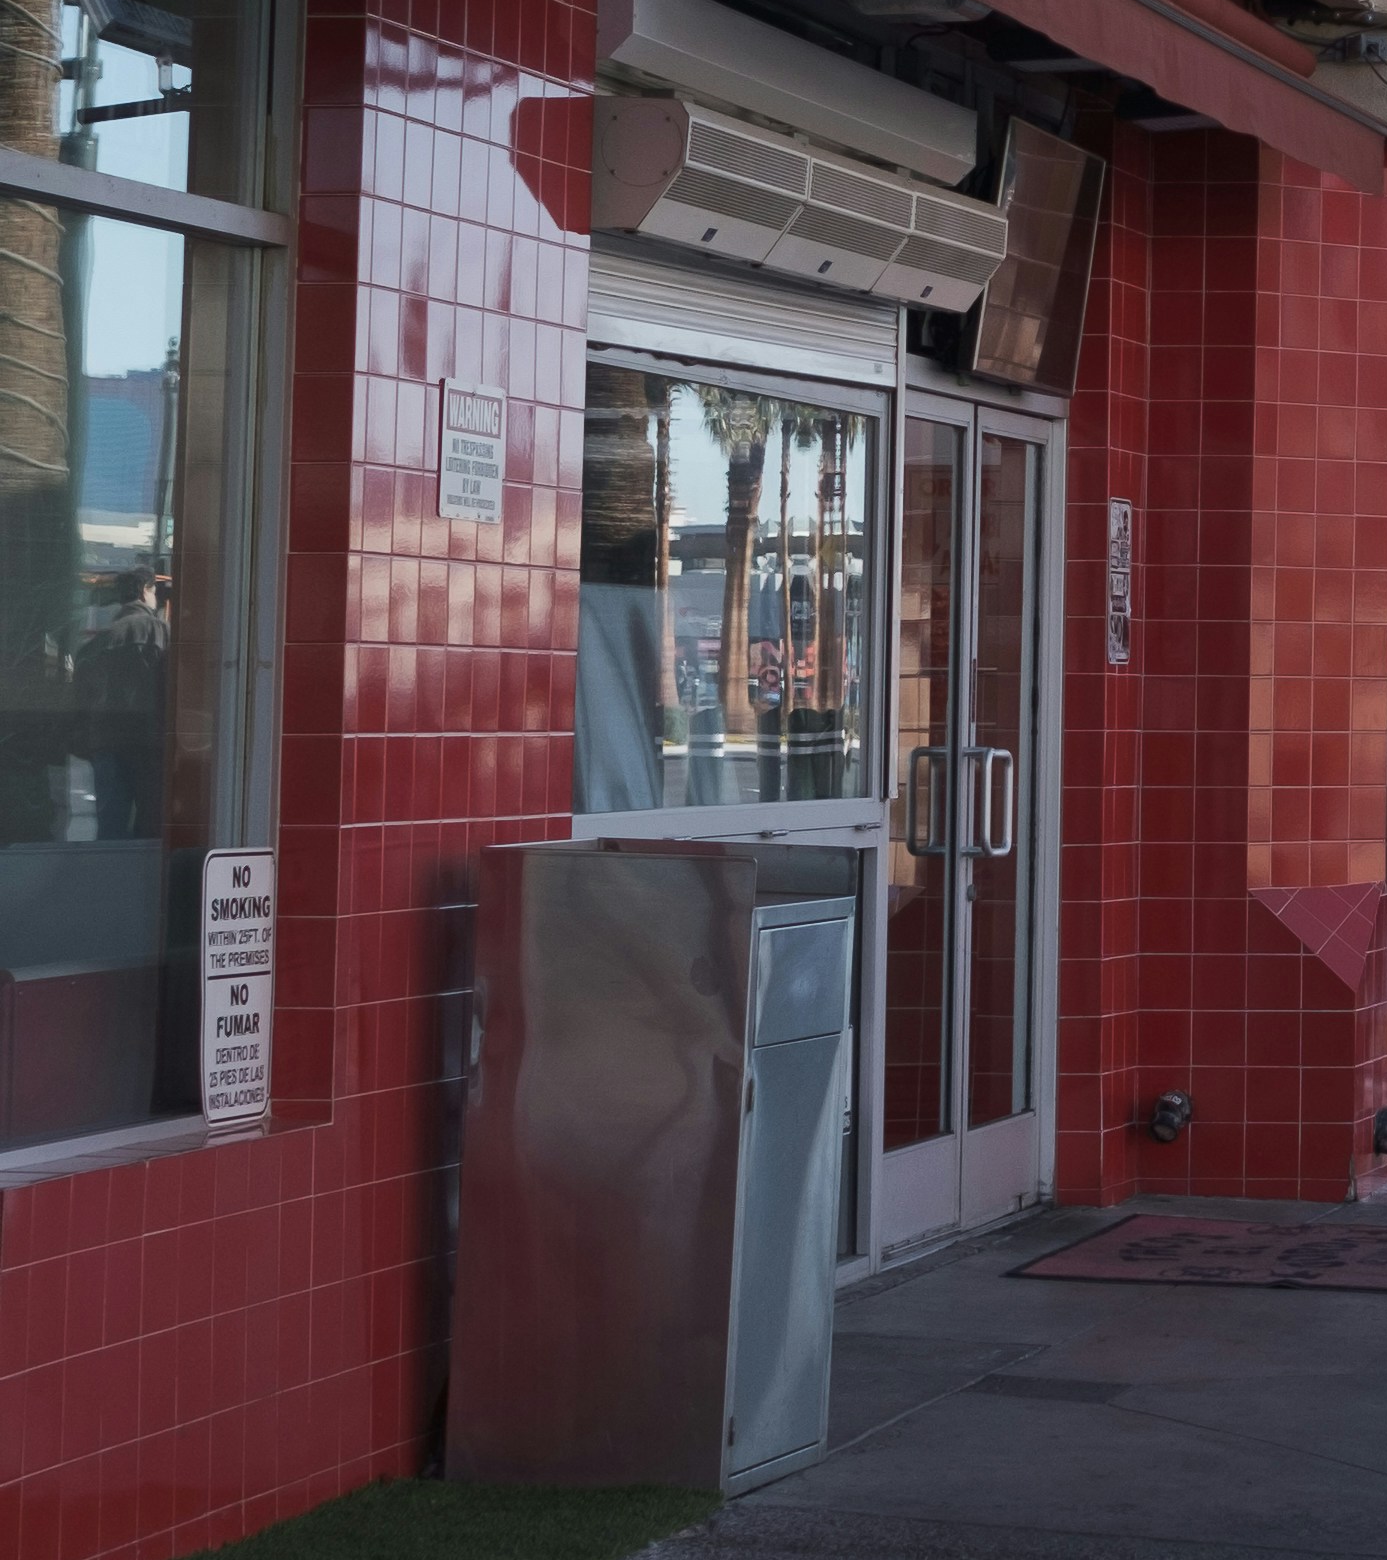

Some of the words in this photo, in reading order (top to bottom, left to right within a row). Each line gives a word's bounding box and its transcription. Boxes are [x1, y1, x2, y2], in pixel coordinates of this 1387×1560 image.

[449, 392, 500, 436] WARNING
[232, 864, 252, 889] NO
[211, 895, 271, 922] SMOKING
[208, 930, 238, 948] WITHIN
[210, 953, 227, 970] THE
[228, 948, 270, 967] PREMISES
[230, 983, 249, 1007] NO
[216, 1012, 260, 1039] FUMAR
[215, 1044, 248, 1065] DENTRO
[249, 1042, 260, 1061] DE
[209, 1070, 219, 1088] 25
[219, 1067, 239, 1086] PIES
[239, 1066, 250, 1083] DE
[250, 1064, 265, 1082] LAS
[208, 1092, 266, 1111] INSTALACIONES
